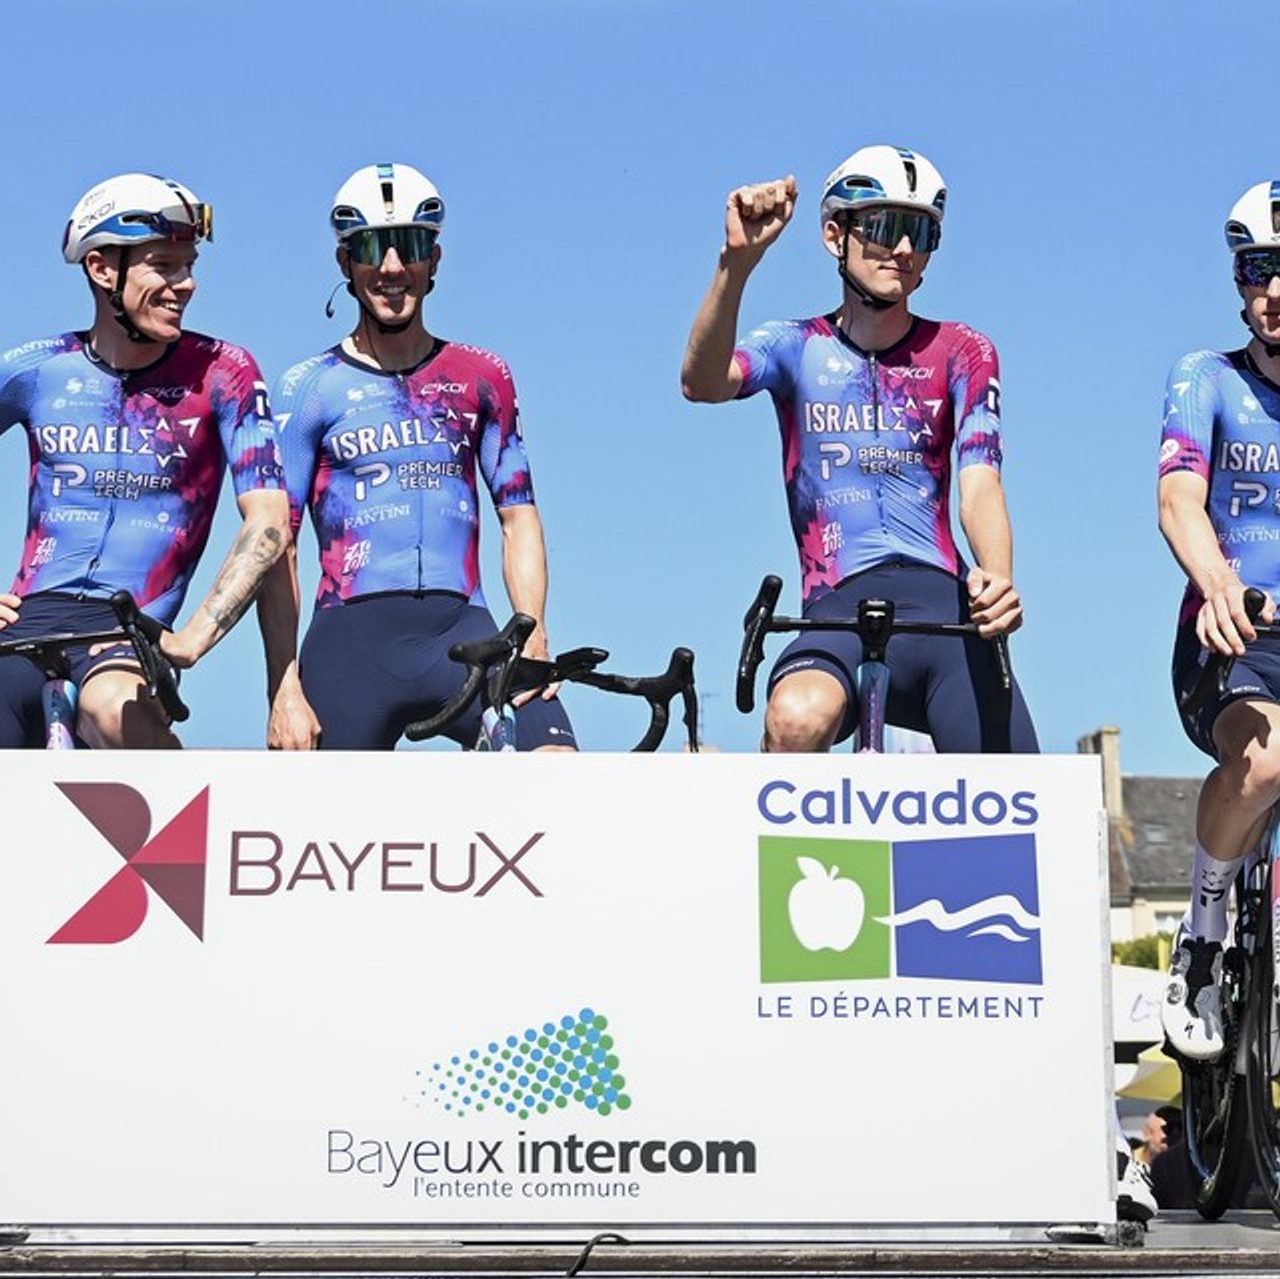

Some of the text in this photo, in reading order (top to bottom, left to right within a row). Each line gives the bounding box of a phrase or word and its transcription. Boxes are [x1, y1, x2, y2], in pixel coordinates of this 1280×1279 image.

[805, 401, 889, 433] ISRAEL
[34, 425, 133, 455] ISRAEL
[330, 419, 429, 461] ISRAEL
[398, 461, 463, 478] PREMIER
[858, 446, 924, 466] PREMIER
[94, 470, 172, 490] PREMIER
[94, 484, 140, 501] TECH
[399, 477, 440, 491] TECH
[344, 505, 410, 530] FANTINI
[757, 778, 1039, 826] Calvados
[229, 830, 548, 898] BAYEUX
[758, 989, 1044, 1018] LE DÉPARTEMENT
[328, 1130, 757, 1188] Bayeux intercom
[414, 1177, 640, 1198] l'entente commune
